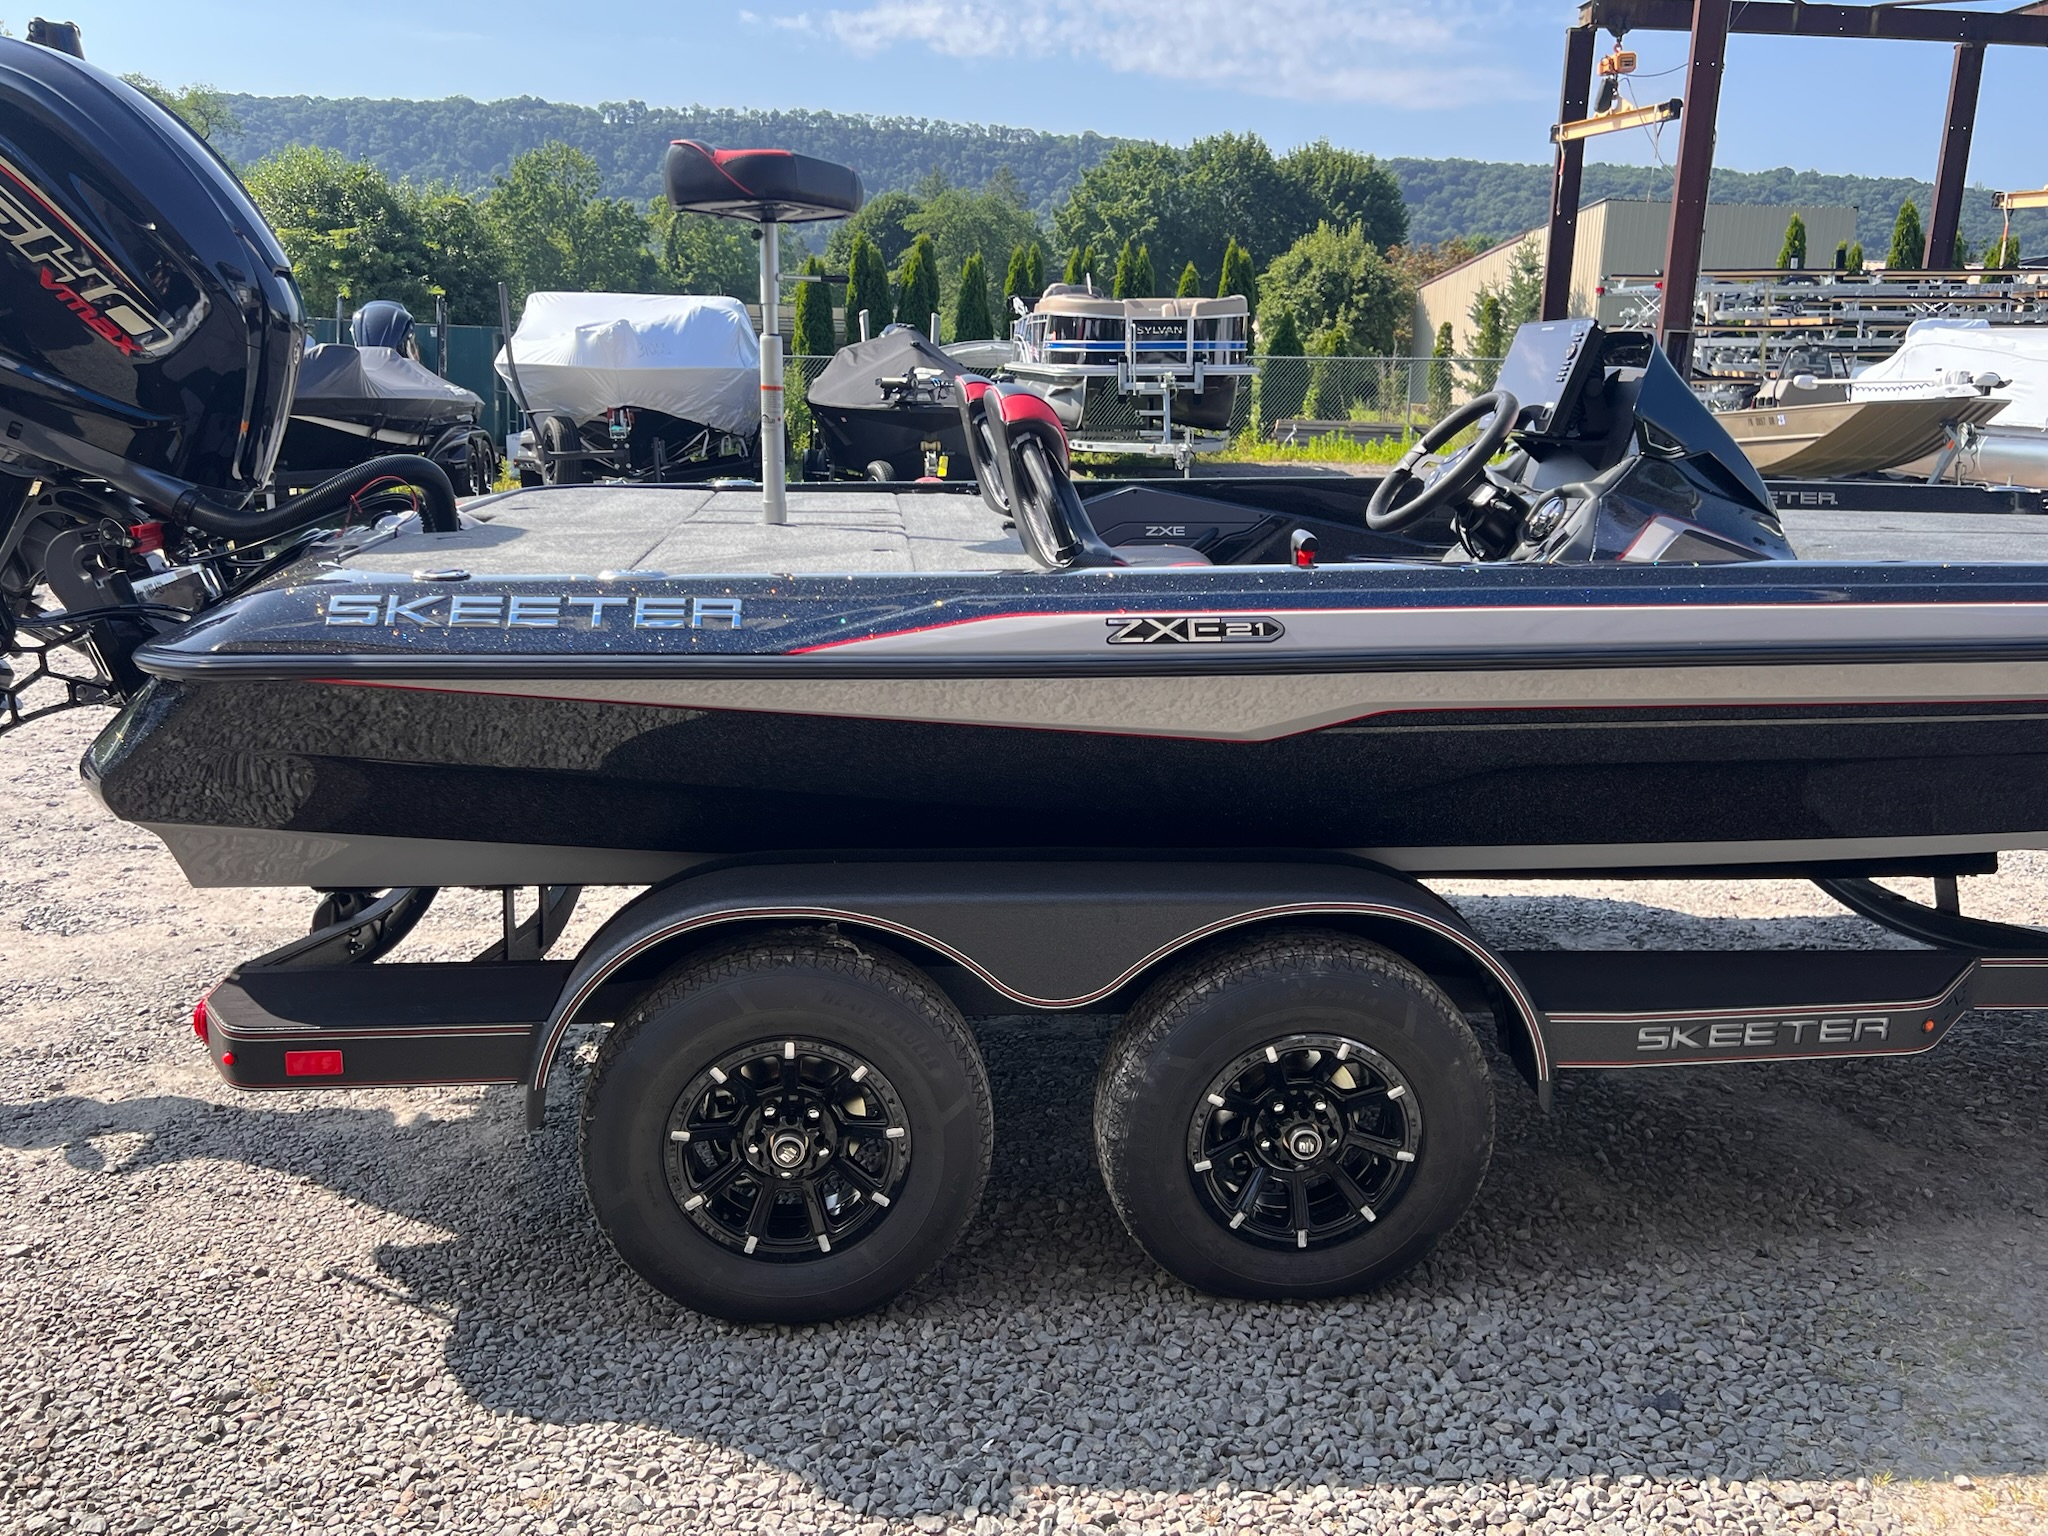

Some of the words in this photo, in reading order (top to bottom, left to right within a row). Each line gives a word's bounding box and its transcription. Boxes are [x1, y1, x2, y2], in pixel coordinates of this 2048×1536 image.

[1136, 325, 1183, 335] SYLVAN
[1145, 526, 1186, 537] ZXE
[324, 594, 743, 630] SKEETER
[1636, 1016, 1890, 1051] SKEETER
